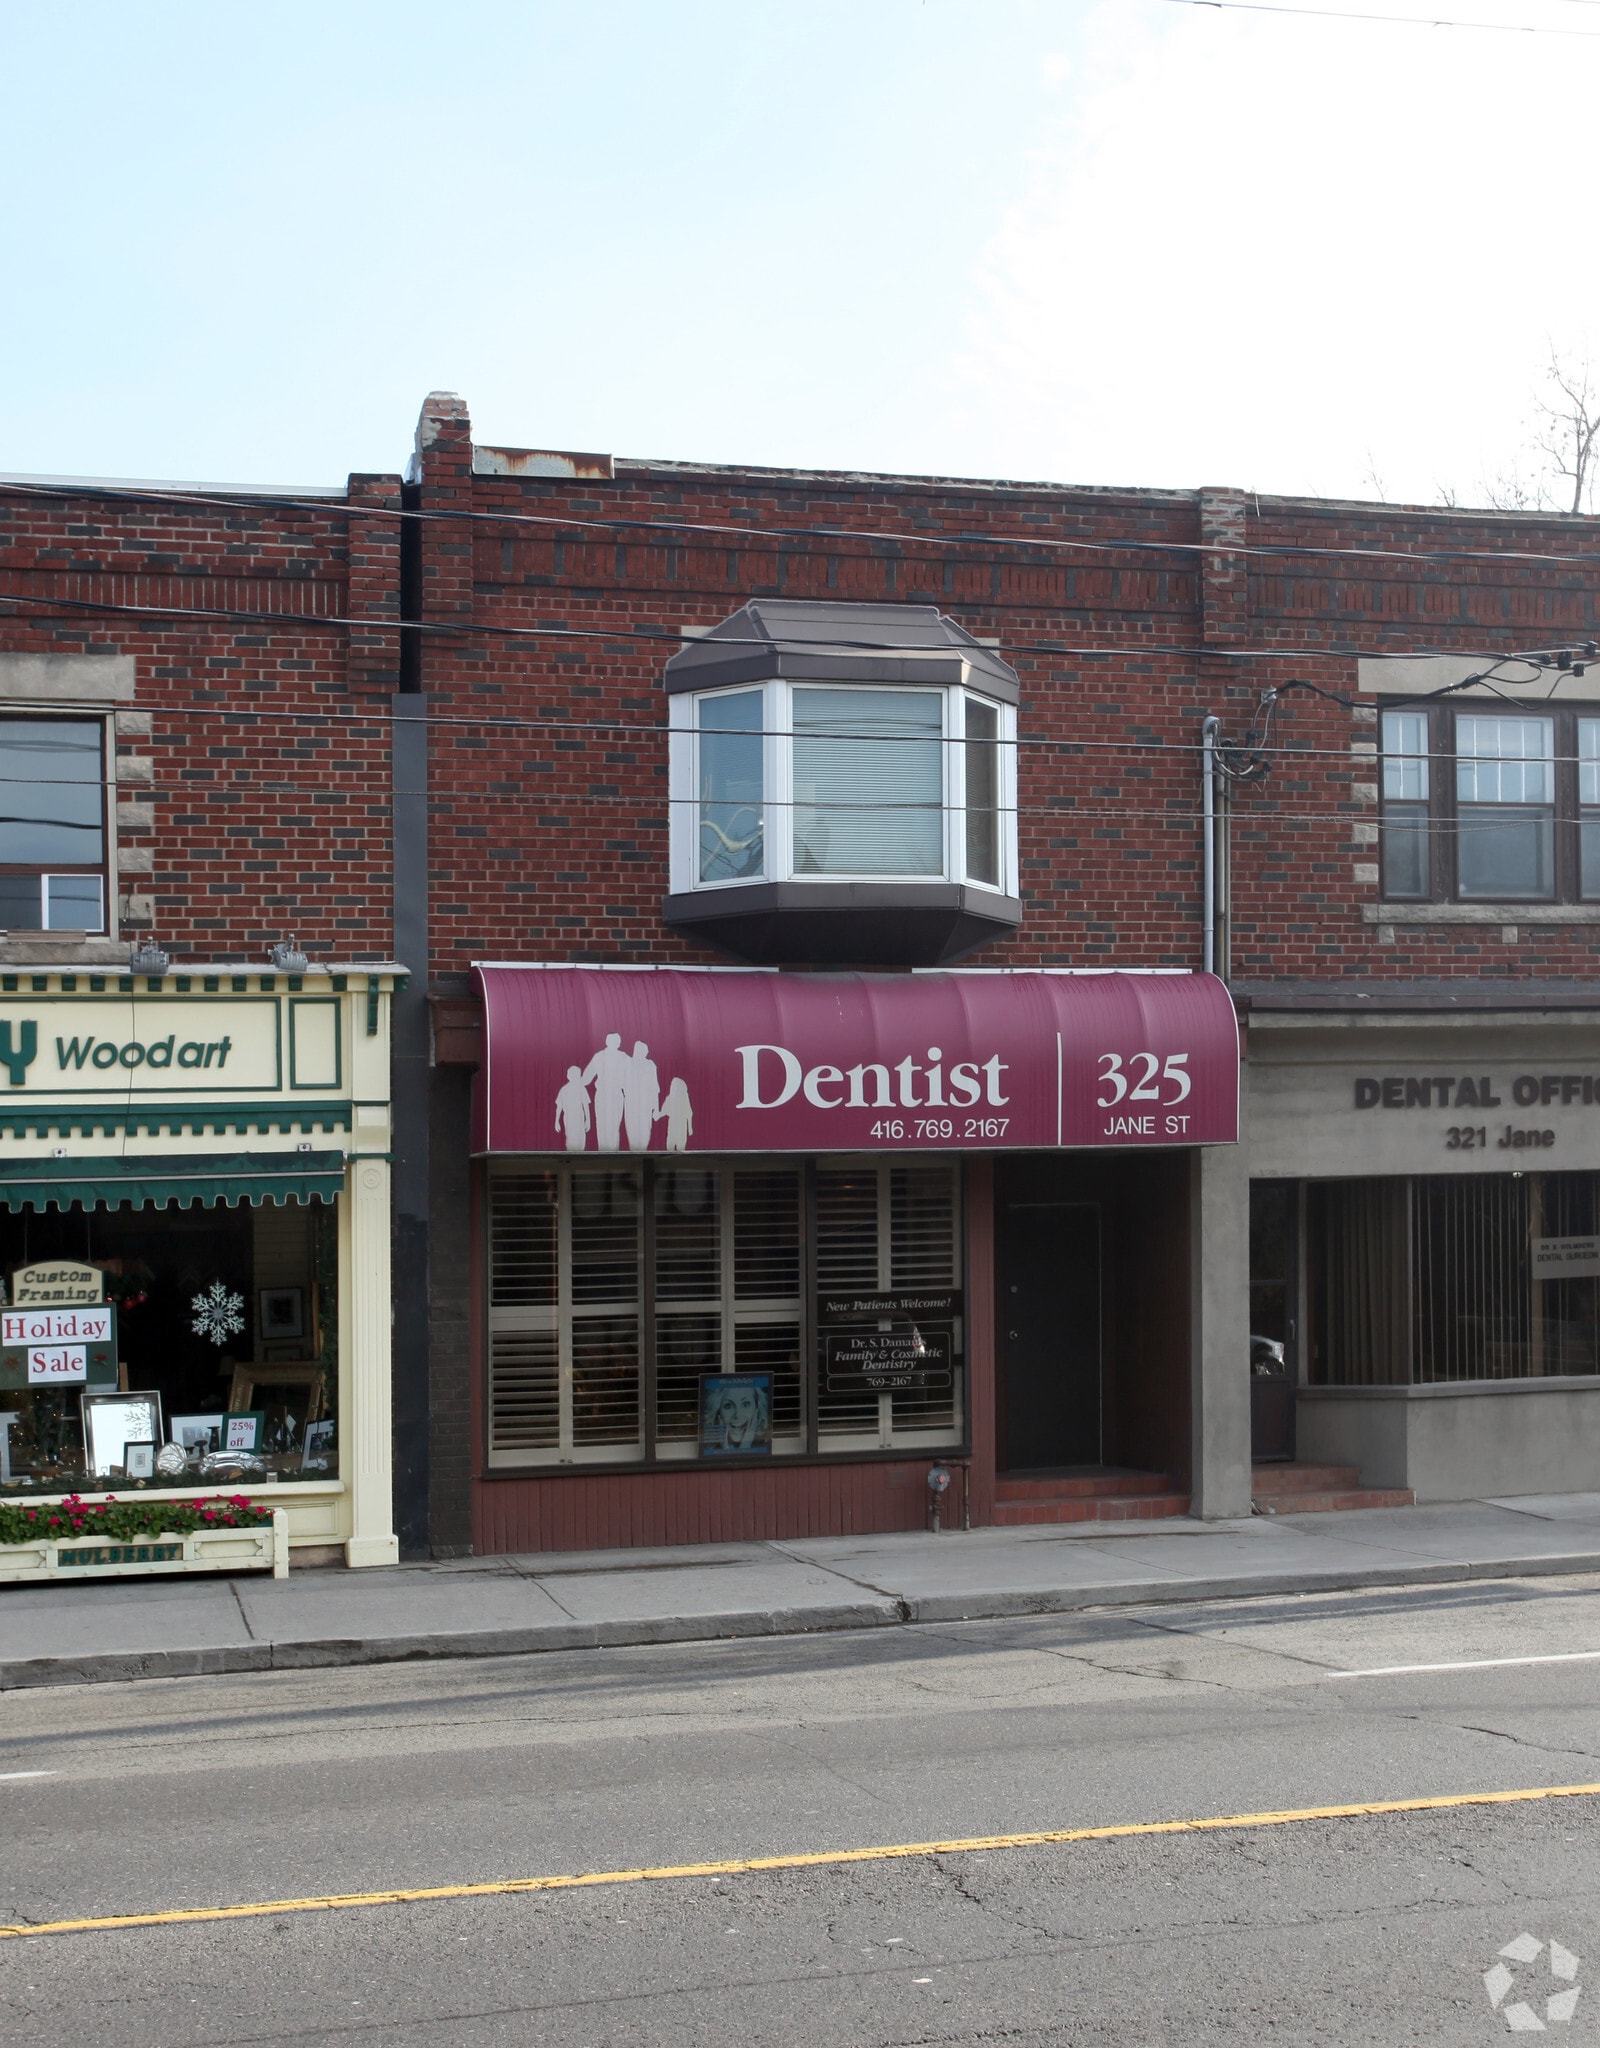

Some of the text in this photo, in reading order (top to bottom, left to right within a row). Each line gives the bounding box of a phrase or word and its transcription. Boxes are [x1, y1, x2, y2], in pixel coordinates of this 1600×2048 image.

[55, 1034, 232, 1070] Woodart
[734, 1044, 1010, 1109] Dentist
[1096, 1052, 1192, 1109] 325
[1354, 1075, 1600, 1109] DENTAL OFFI
[870, 1118, 1010, 1139] 416.769.2167
[1103, 1115, 1191, 1136] JANE ST
[1446, 1125, 1556, 1149] 321 Jane
[1537, 1253, 1564, 1262] DENTAL
[24, 1270, 92, 1283] Custom
[17, 1287, 99, 1302] Framing
[826, 1298, 951, 1312] New Patients Welcome!
[4, 1315, 107, 1339] Holiday
[851, 1338, 867, 1348] Dr.
[869, 1338, 878, 1348] S.
[32, 1351, 83, 1373] Sale
[835, 1350, 876, 1361] Family
[878, 1349, 888, 1359] &
[862, 1359, 916, 1371] Dentistry
[866, 1376, 912, 1388] 769-2167
[231, 1421, 255, 1432] 25%
[229, 1437, 245, 1448] off
[61, 1545, 180, 1565] MULBERRY
